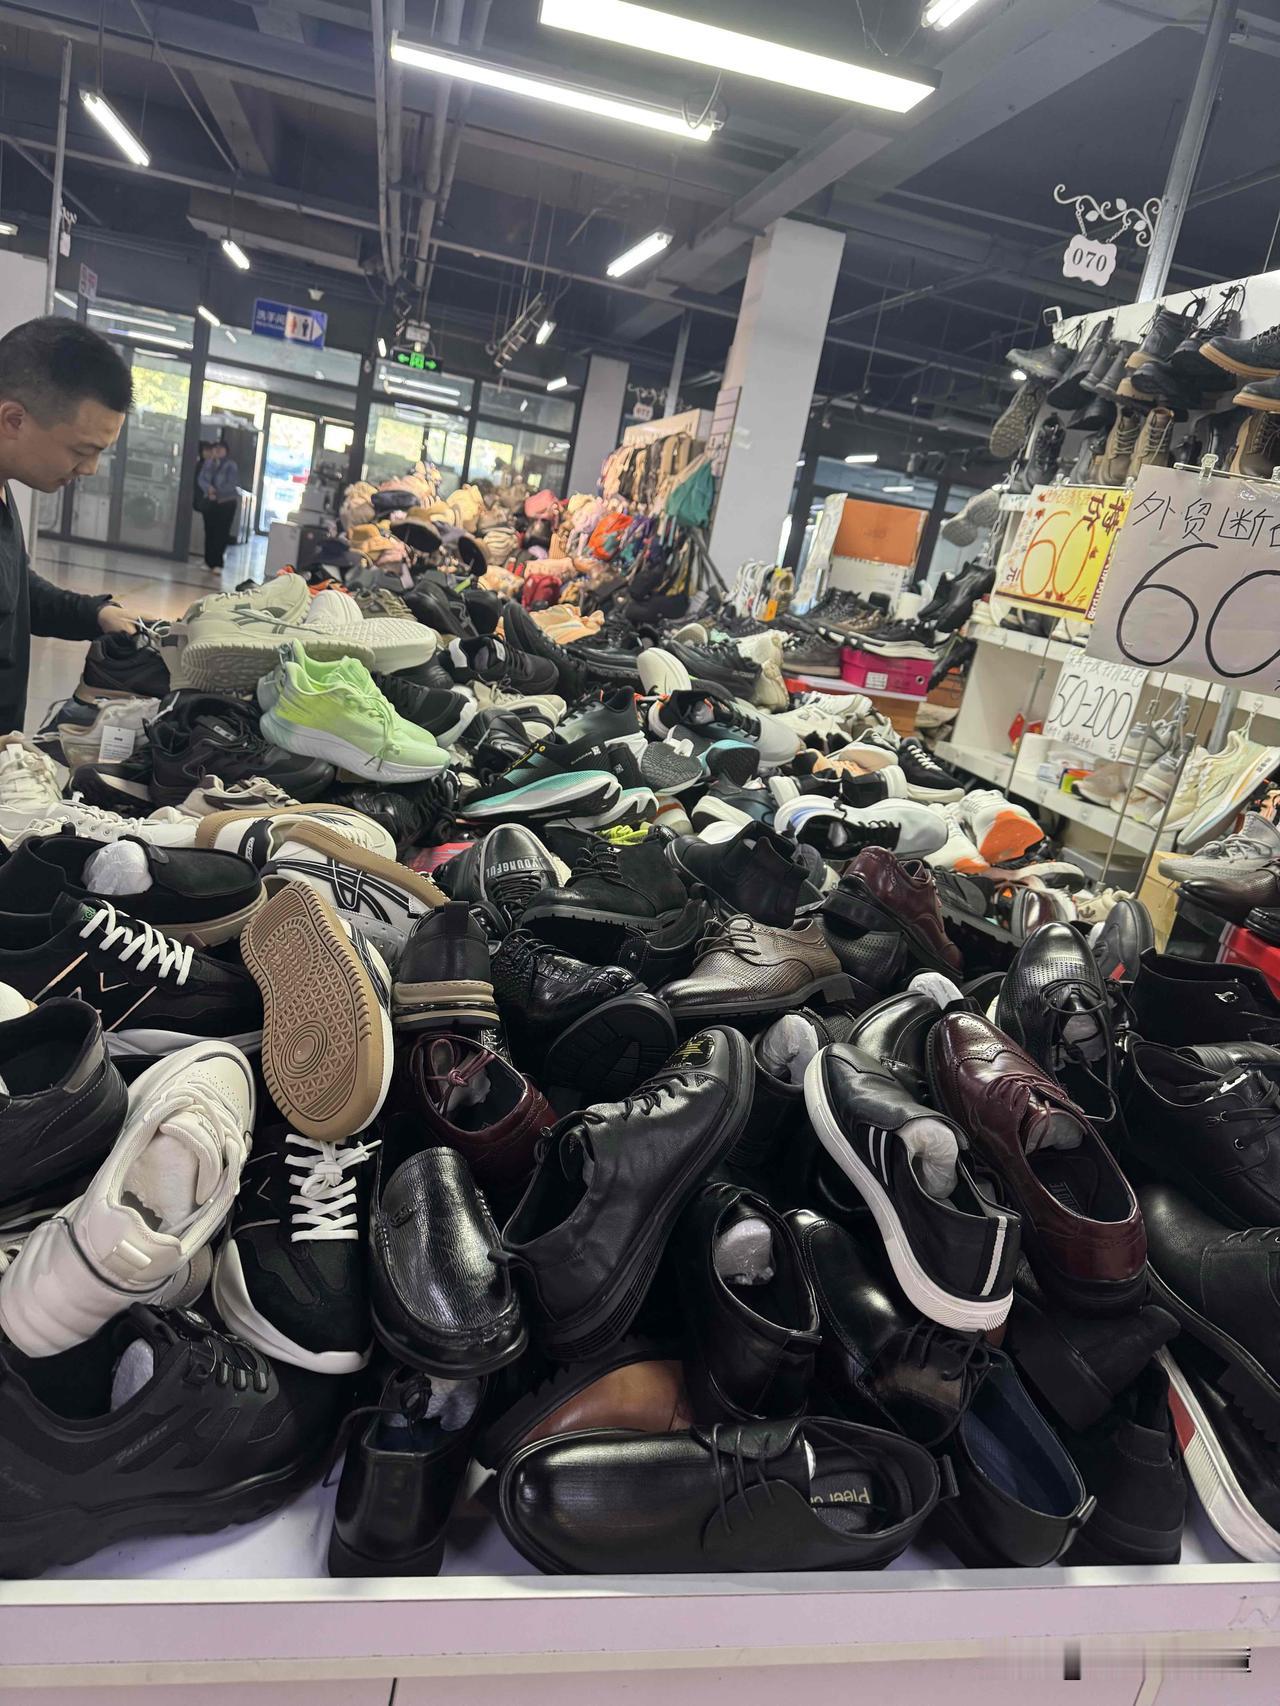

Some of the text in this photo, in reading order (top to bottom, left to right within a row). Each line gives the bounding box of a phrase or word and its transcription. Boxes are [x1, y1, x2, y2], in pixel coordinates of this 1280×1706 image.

[1072, 248, 1107, 272] 070
[1021, 510, 1095, 597] 60
[1116, 542, 1280, 678] 60
[1048, 674, 1133, 740] 50-200
